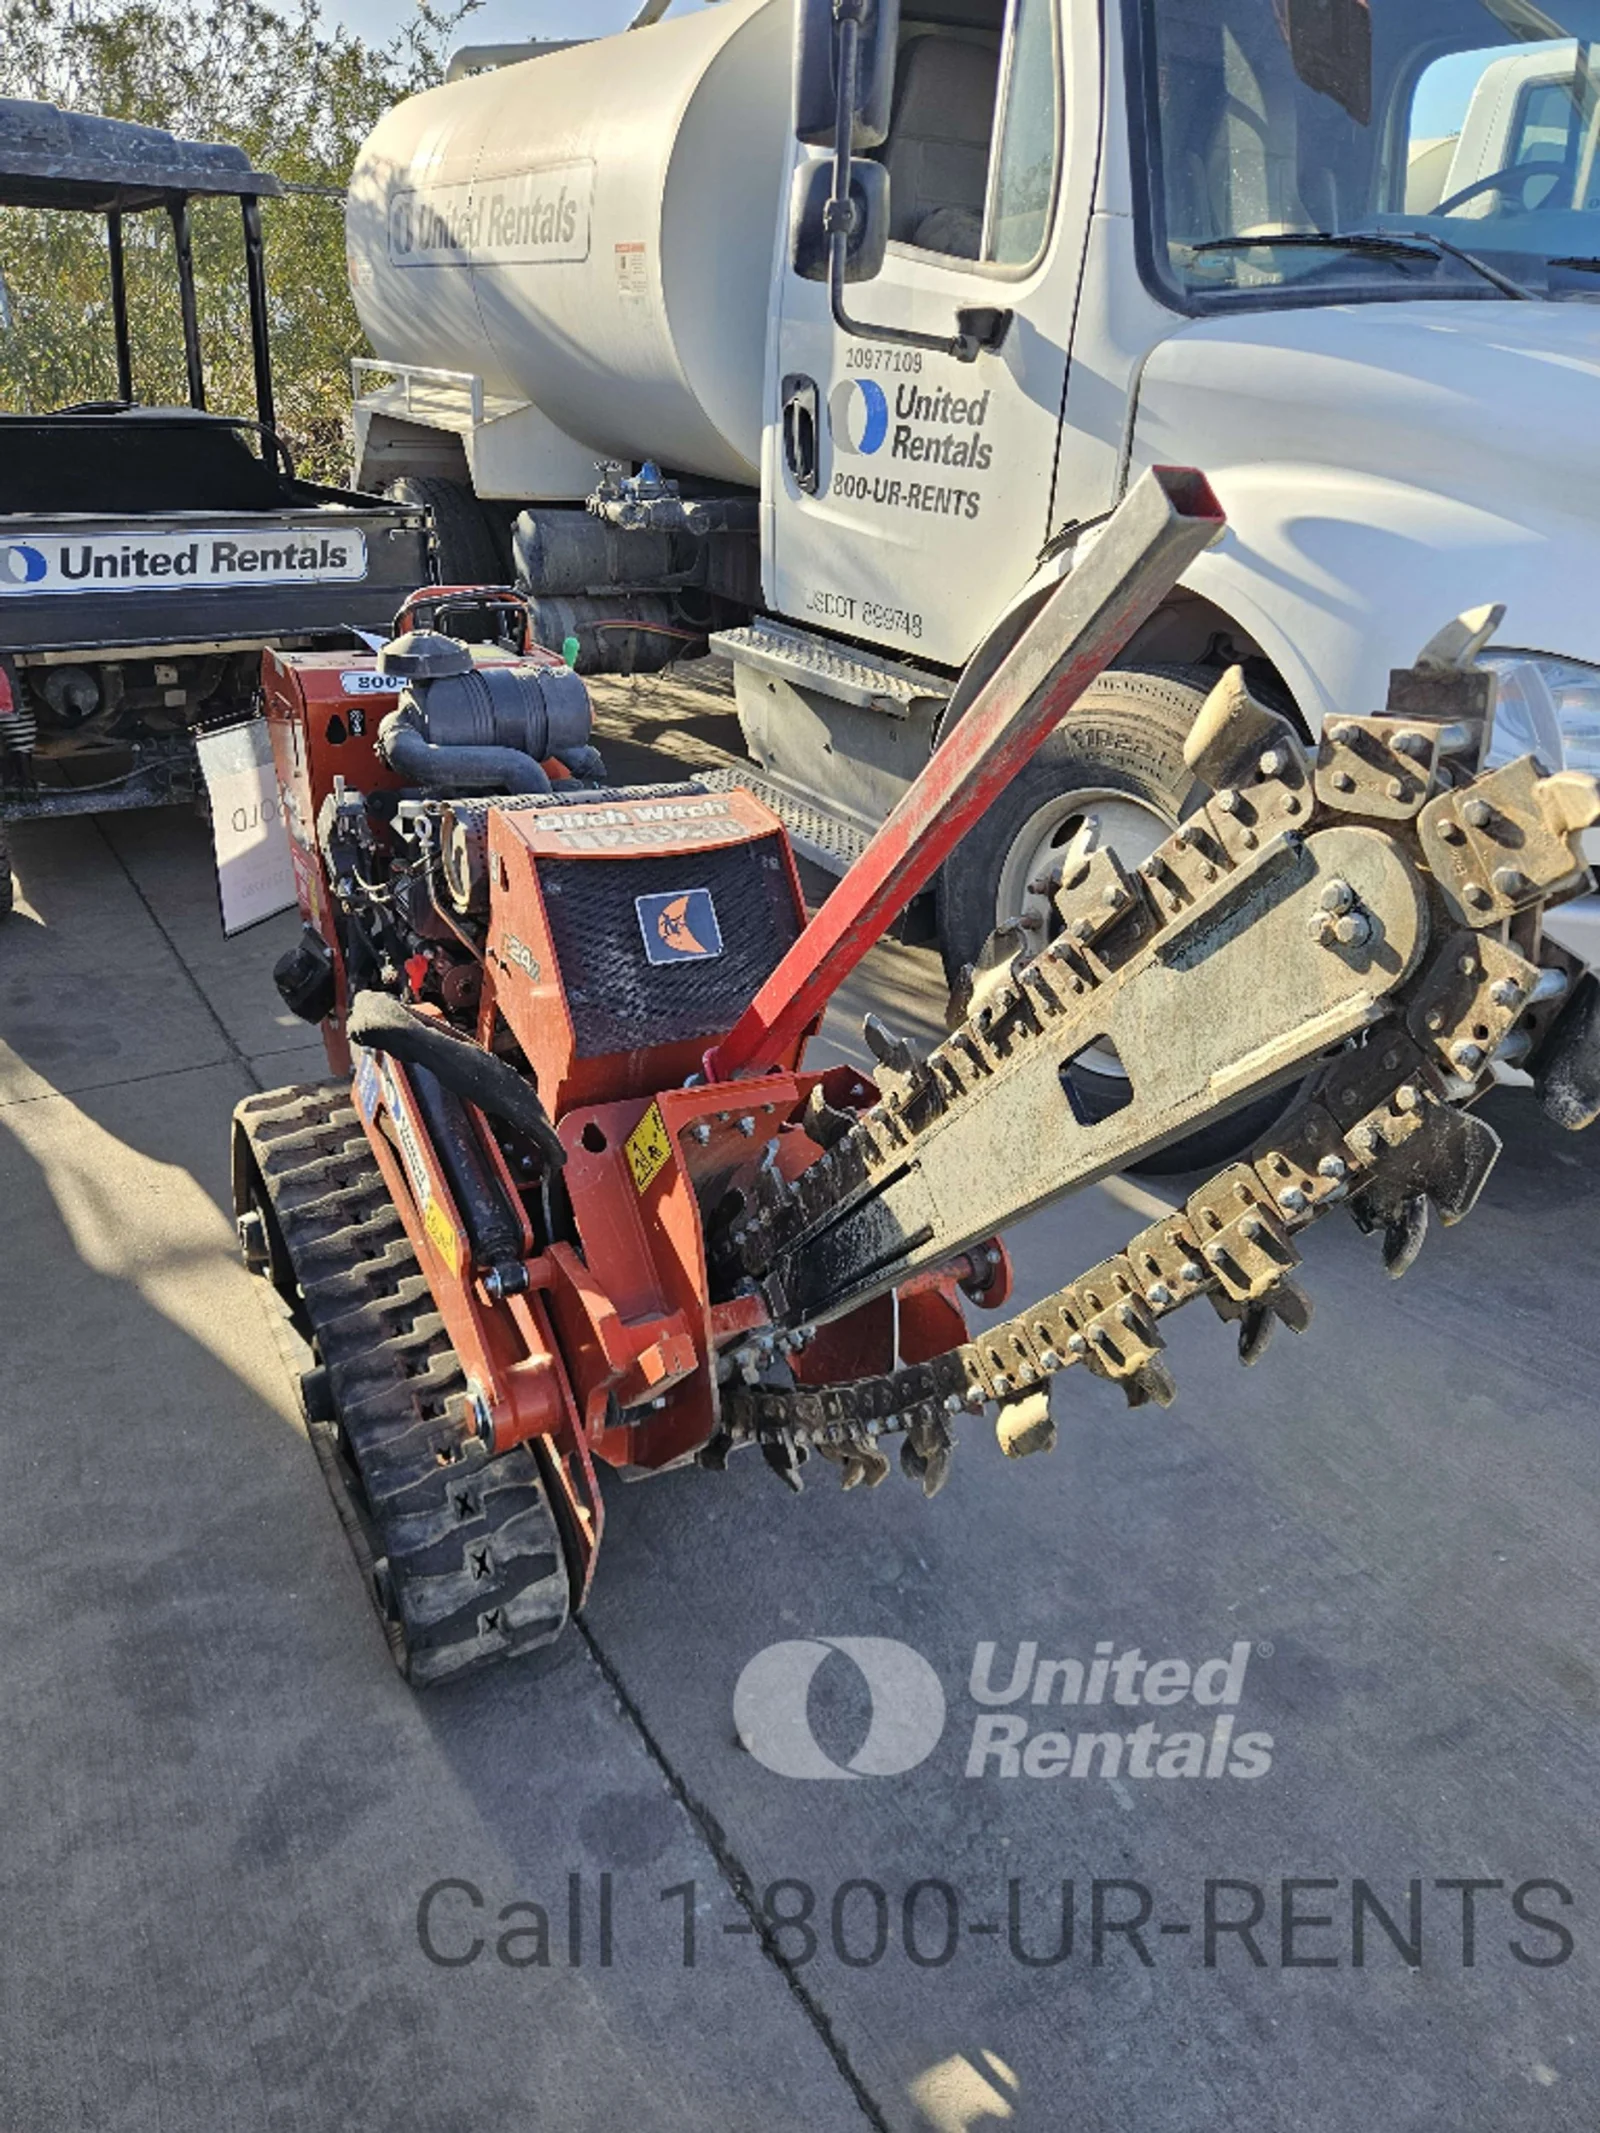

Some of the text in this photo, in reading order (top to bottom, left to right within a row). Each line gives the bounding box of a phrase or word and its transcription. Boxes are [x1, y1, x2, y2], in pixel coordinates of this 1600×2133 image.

[418, 185, 577, 250] United Rentals
[845, 348, 923, 373] 10977109
[895, 383, 990, 426] United
[891, 425, 993, 470] Rentals
[833, 473, 980, 520] 800-UR-RENTS
[60, 539, 347, 579] United Rentals
[806, 590, 857, 620] SDOT
[535, 800, 729, 831] Ditch Witch
